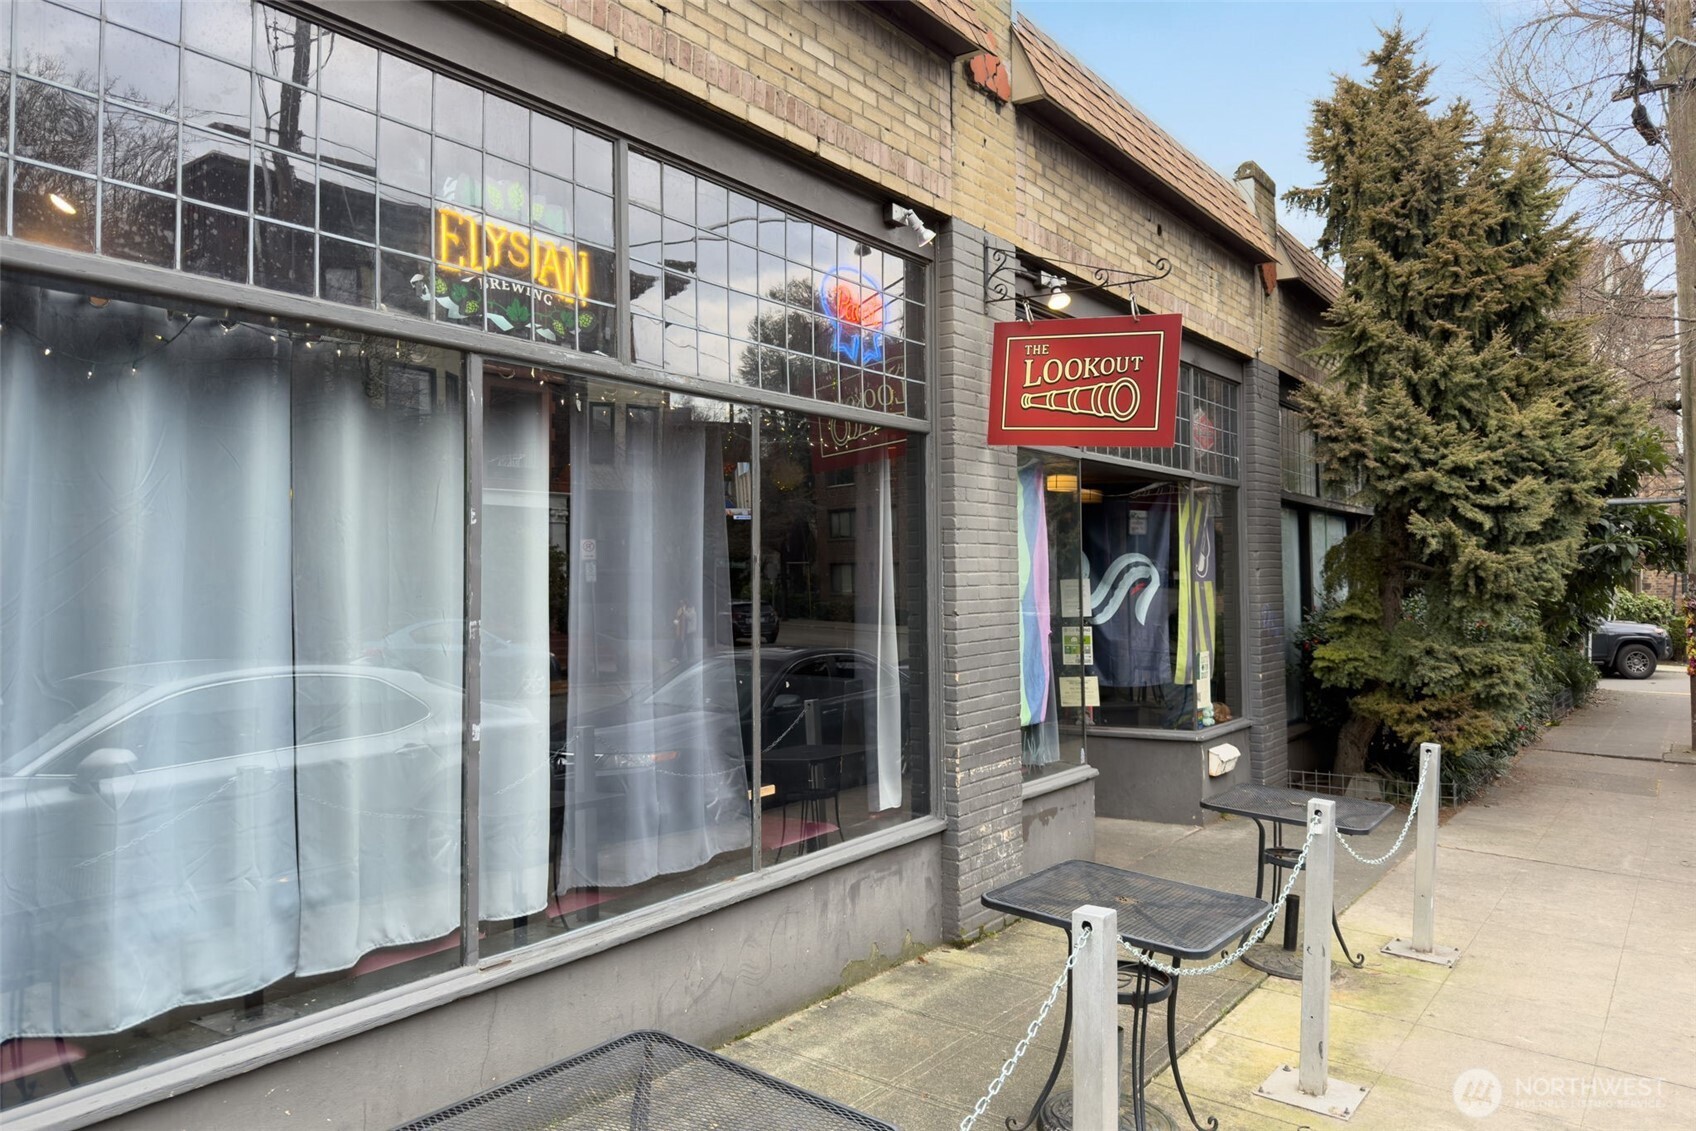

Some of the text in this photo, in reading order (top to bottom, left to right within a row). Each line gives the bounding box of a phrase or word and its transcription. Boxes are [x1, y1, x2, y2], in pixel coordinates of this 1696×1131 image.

[438, 207, 590, 307] ELYSIAN
[1024, 344, 1050, 355] THE
[1022, 355, 1144, 388] LOOKOUT
